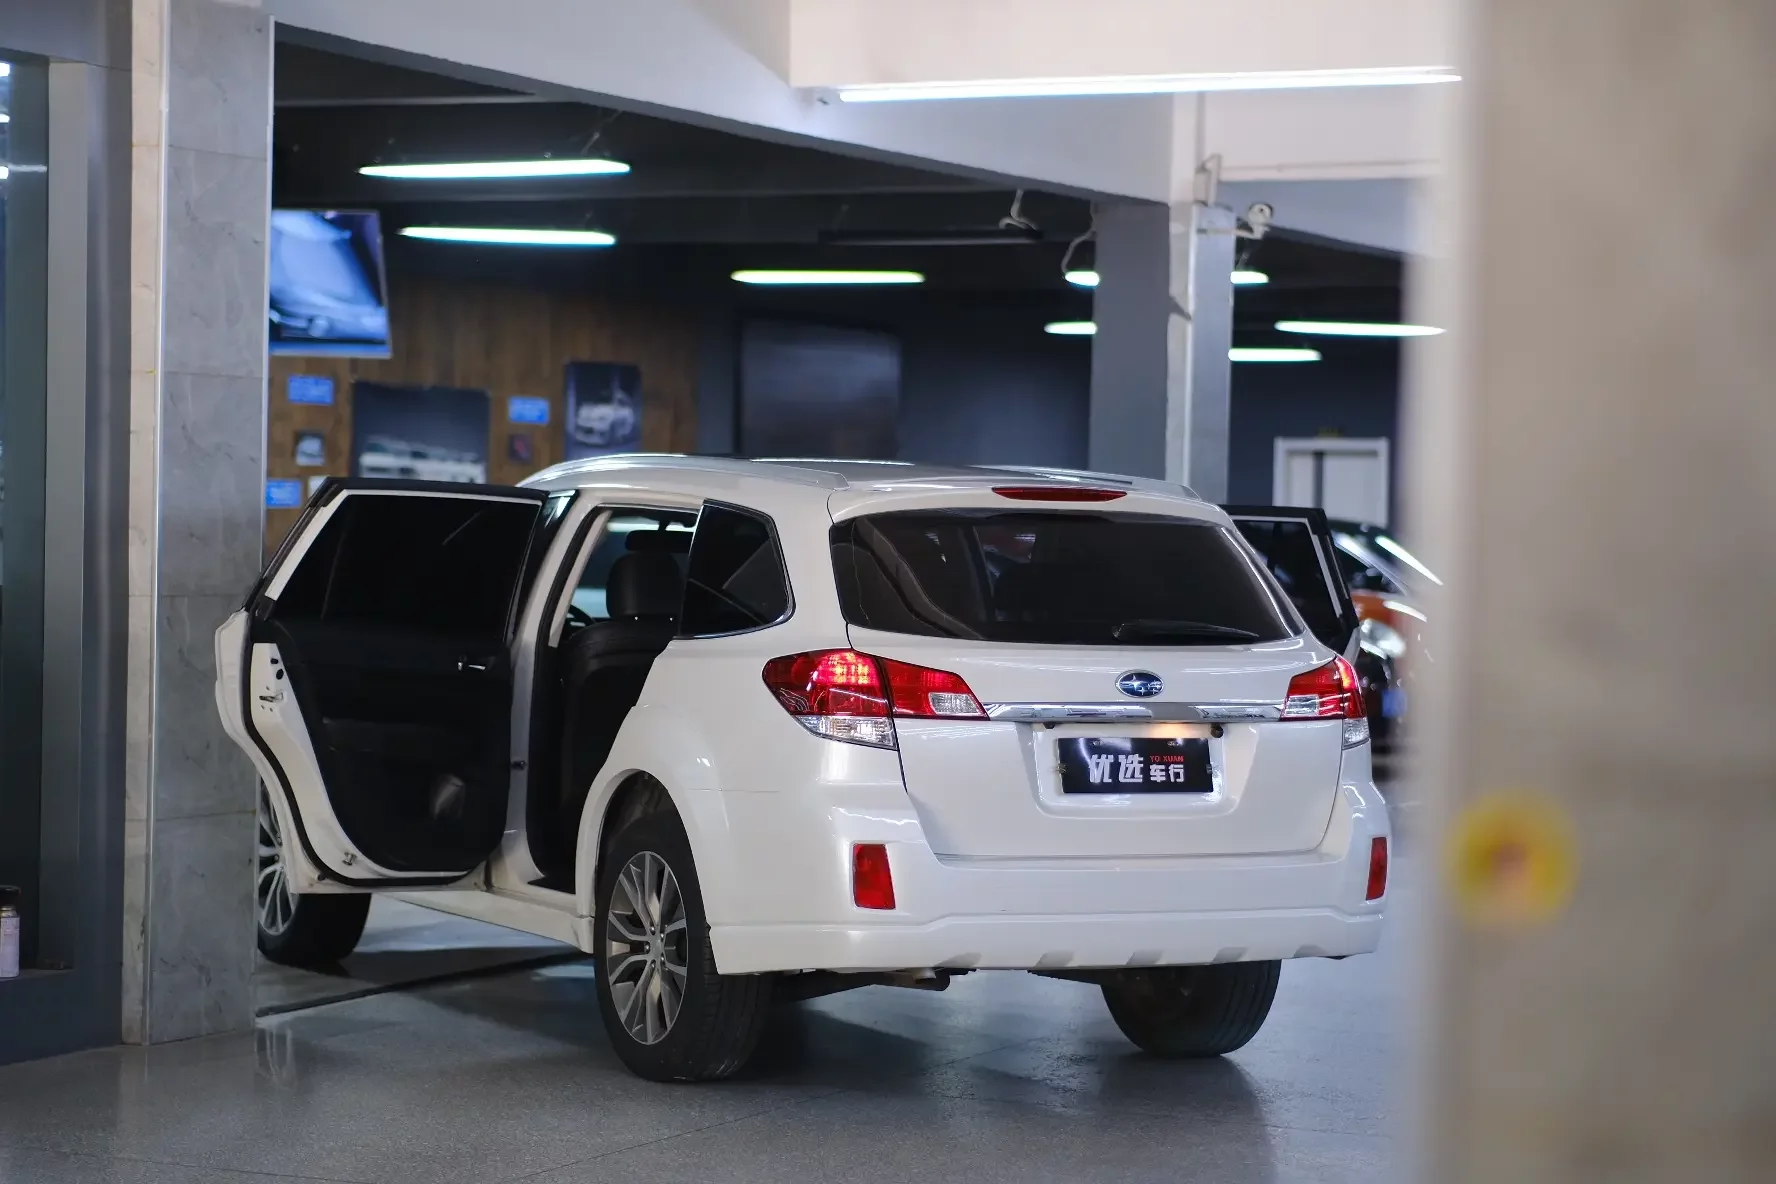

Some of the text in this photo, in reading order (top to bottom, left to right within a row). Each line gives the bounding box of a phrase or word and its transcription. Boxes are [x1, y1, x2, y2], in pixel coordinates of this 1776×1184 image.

[1089, 754, 1144, 783] 优选
[1163, 755, 1184, 763] XUAN
[1150, 764, 1184, 783] 车行
